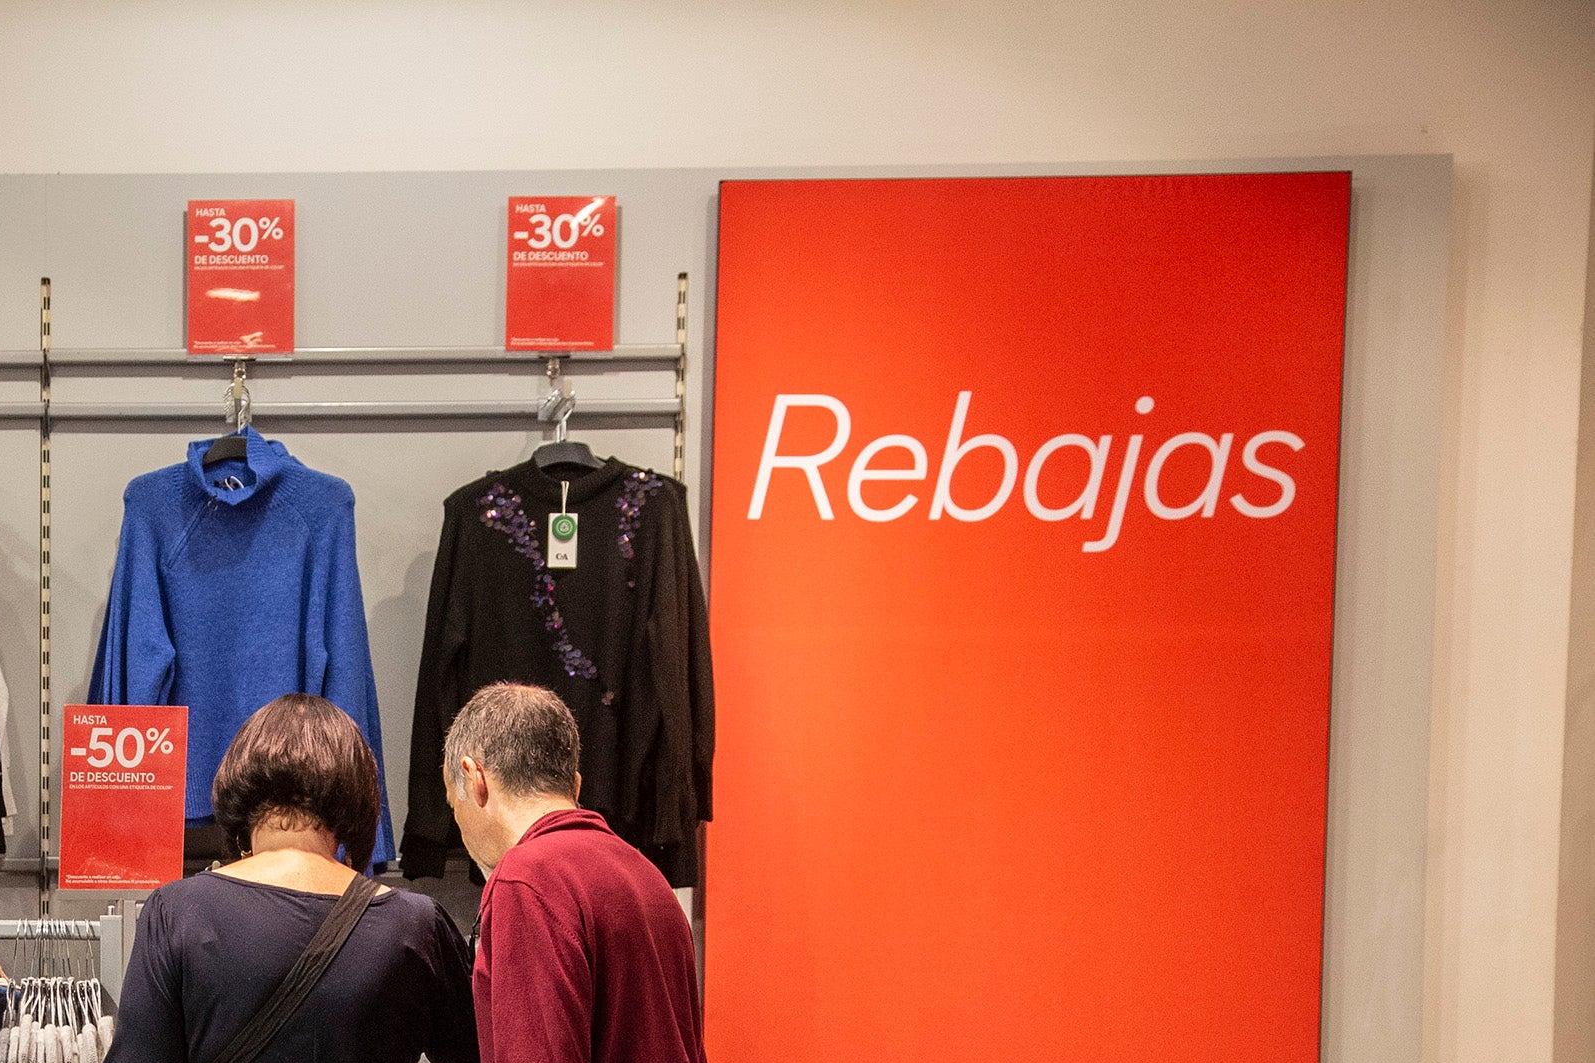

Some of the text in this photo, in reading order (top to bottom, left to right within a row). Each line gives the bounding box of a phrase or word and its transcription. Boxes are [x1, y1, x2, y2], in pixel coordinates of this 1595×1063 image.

[196, 208, 226, 216] HASTA
[515, 204, 546, 213] HASTA
[194, 216, 284, 252] -30%
[513, 213, 604, 249] -30%
[194, 254, 268, 264] DE DESCUENTO
[513, 251, 589, 261] DE DESCUENTO
[747, 391, 1305, 552] Rebajas
[73, 715, 107, 725] HASTA
[70, 727, 174, 768] -50%
[70, 772, 155, 783] DE DESCUENTO
